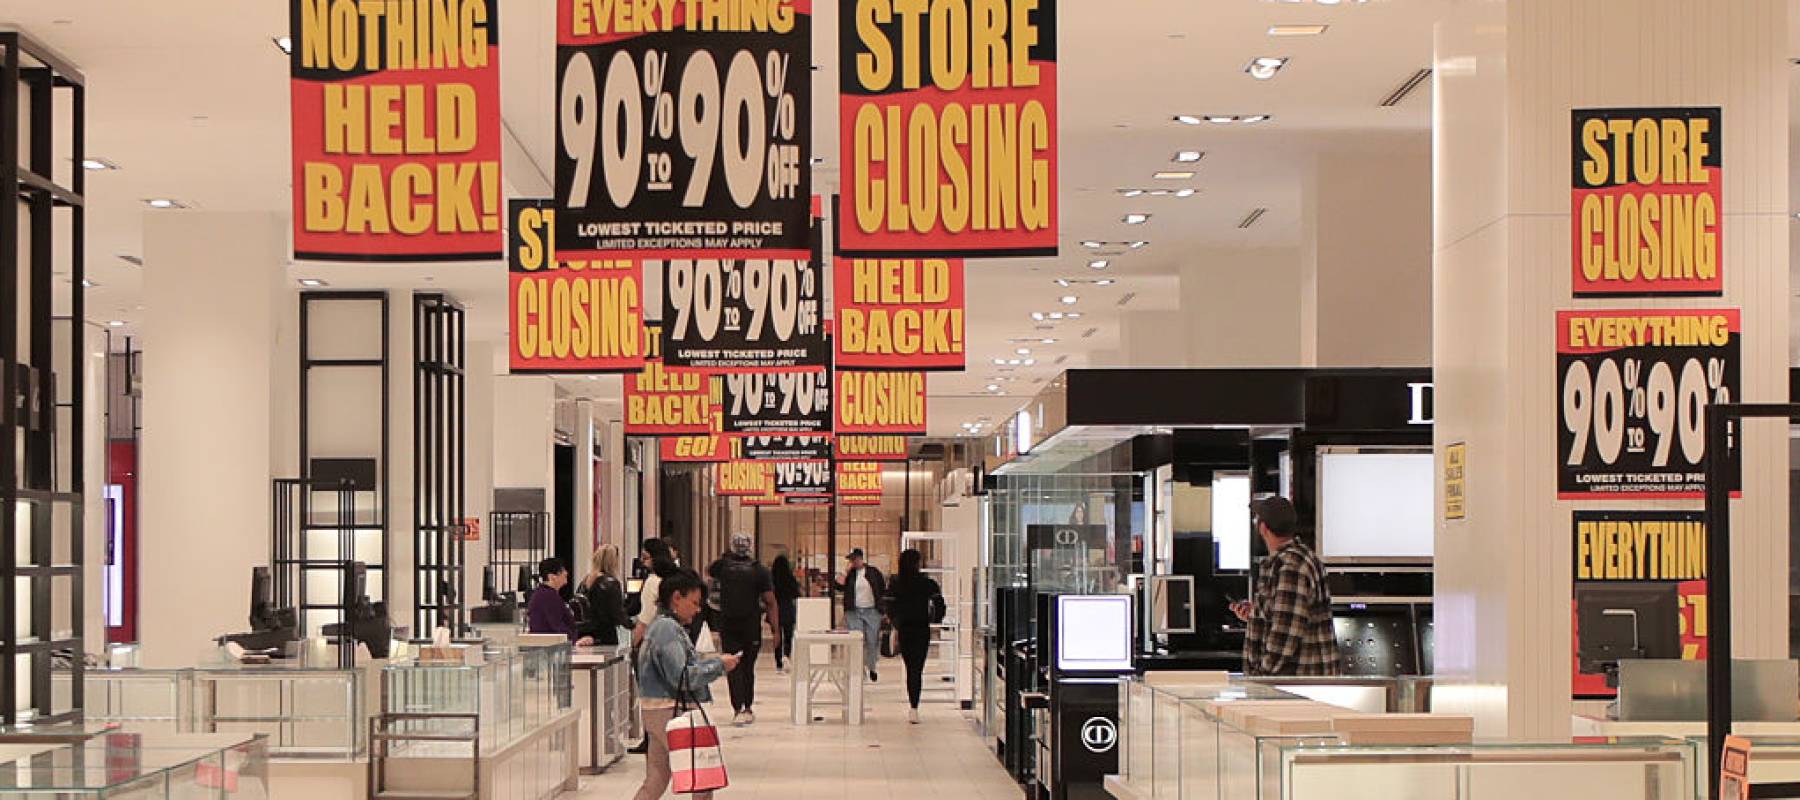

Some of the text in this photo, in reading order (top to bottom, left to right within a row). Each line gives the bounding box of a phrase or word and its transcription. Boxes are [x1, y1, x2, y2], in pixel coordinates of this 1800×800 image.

[301, 0, 488, 70] NOTHING
[573, 0, 795, 36] EVERYTHING
[856, 0, 1040, 92] STORE
[324, 82, 478, 155] HELD
[561, 48, 799, 209] 90% TO 90% OFF
[855, 99, 1049, 235] CLOSING
[1582, 117, 1710, 186] STORE
[303, 160, 499, 235] BACK!
[578, 221, 783, 236] LOWEST TICKETED PRICE
[596, 237, 763, 249] LIMITED EXCEPTIONS MAY APPLY
[1581, 192, 1716, 282] CLOSING
[853, 259, 951, 303] HELD
[518, 275, 639, 359] CLOSING
[724, 307, 740, 327] TO
[842, 308, 963, 354] BACK!
[1569, 315, 1729, 347] EVERYTHING
[636, 362, 700, 391] HELD
[678, 348, 807, 358] LOWEST TICKETED PRICE
[628, 395, 709, 425] BACK!
[841, 371, 924, 426] CLOSING
[1563, 358, 1645, 466] 90%
[1627, 427, 1645, 448] TO
[1576, 473, 1623, 483] LOWEST
[1626, 473, 1683, 483] TICKETED
[1577, 521, 1707, 580] EVERYTHIN
